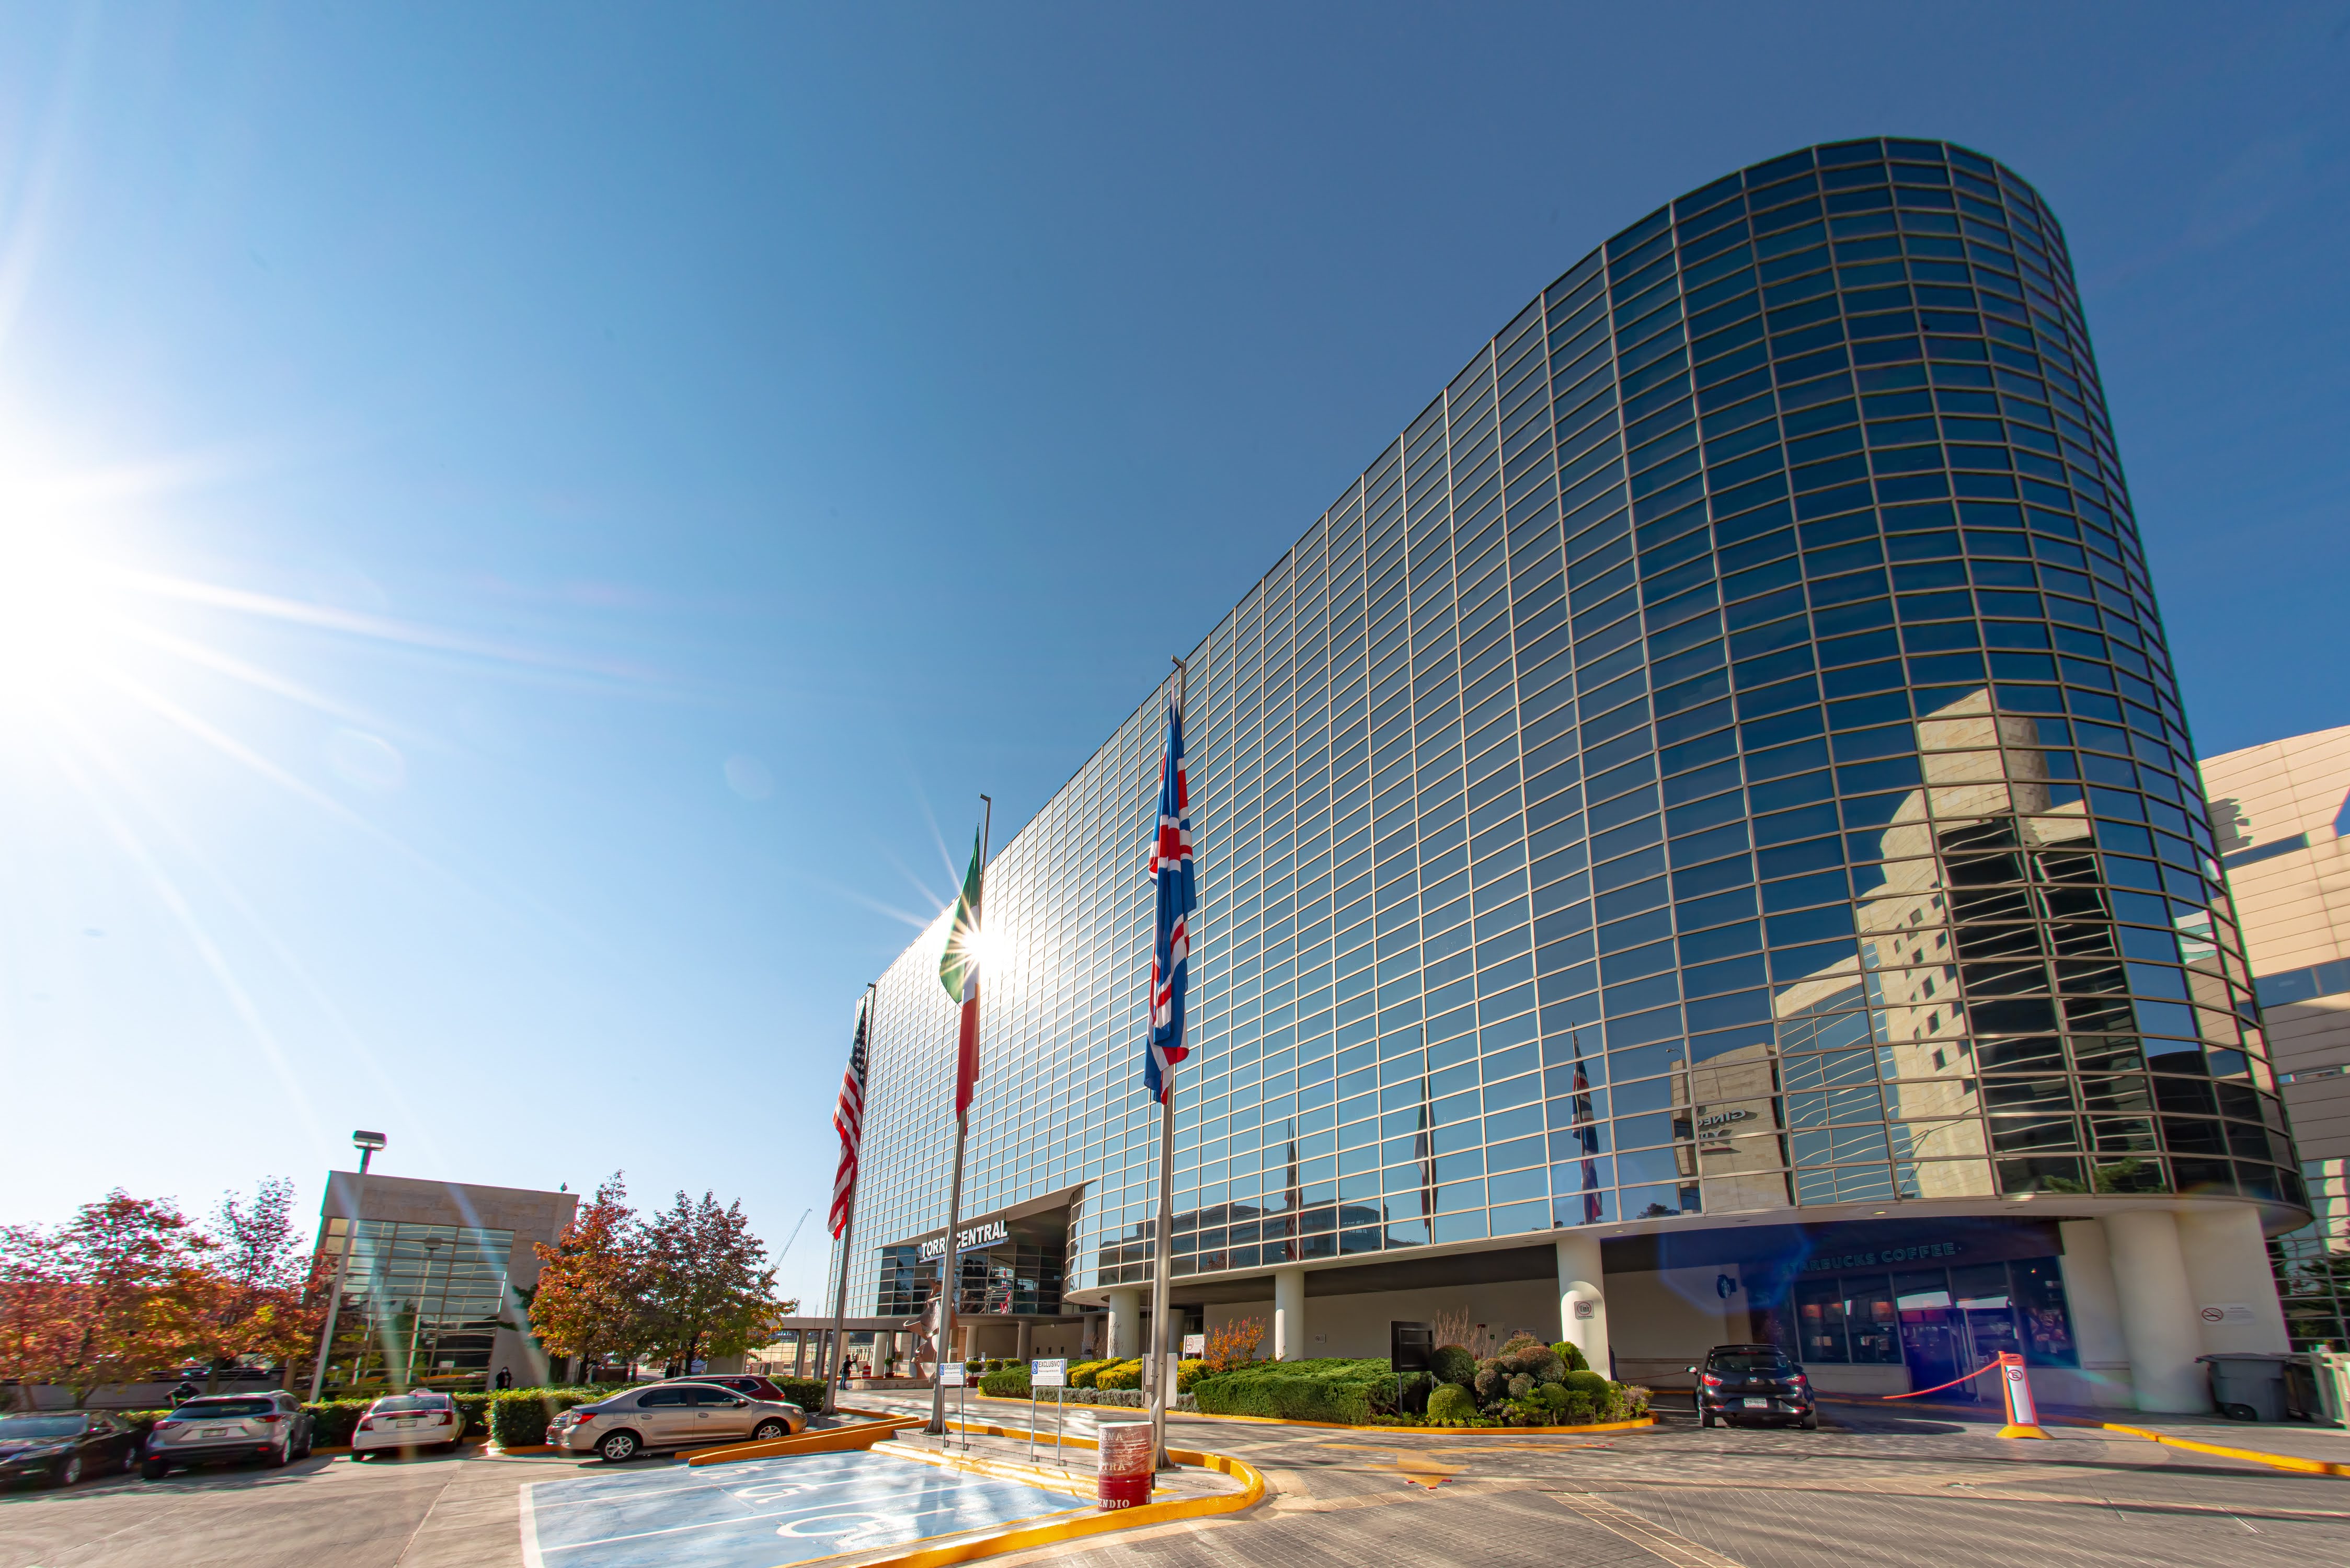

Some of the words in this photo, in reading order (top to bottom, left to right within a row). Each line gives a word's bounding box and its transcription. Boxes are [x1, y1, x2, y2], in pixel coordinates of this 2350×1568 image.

[922, 1237, 946, 1258] TORR
[957, 1219, 1008, 1249] CENTRAL
[1881, 1242, 1956, 1263] COFFEE
[1102, 1432, 1124, 1441] ENA
[1103, 1462, 1126, 1471] TRA
[1098, 1498, 1130, 1508] ENDIO
